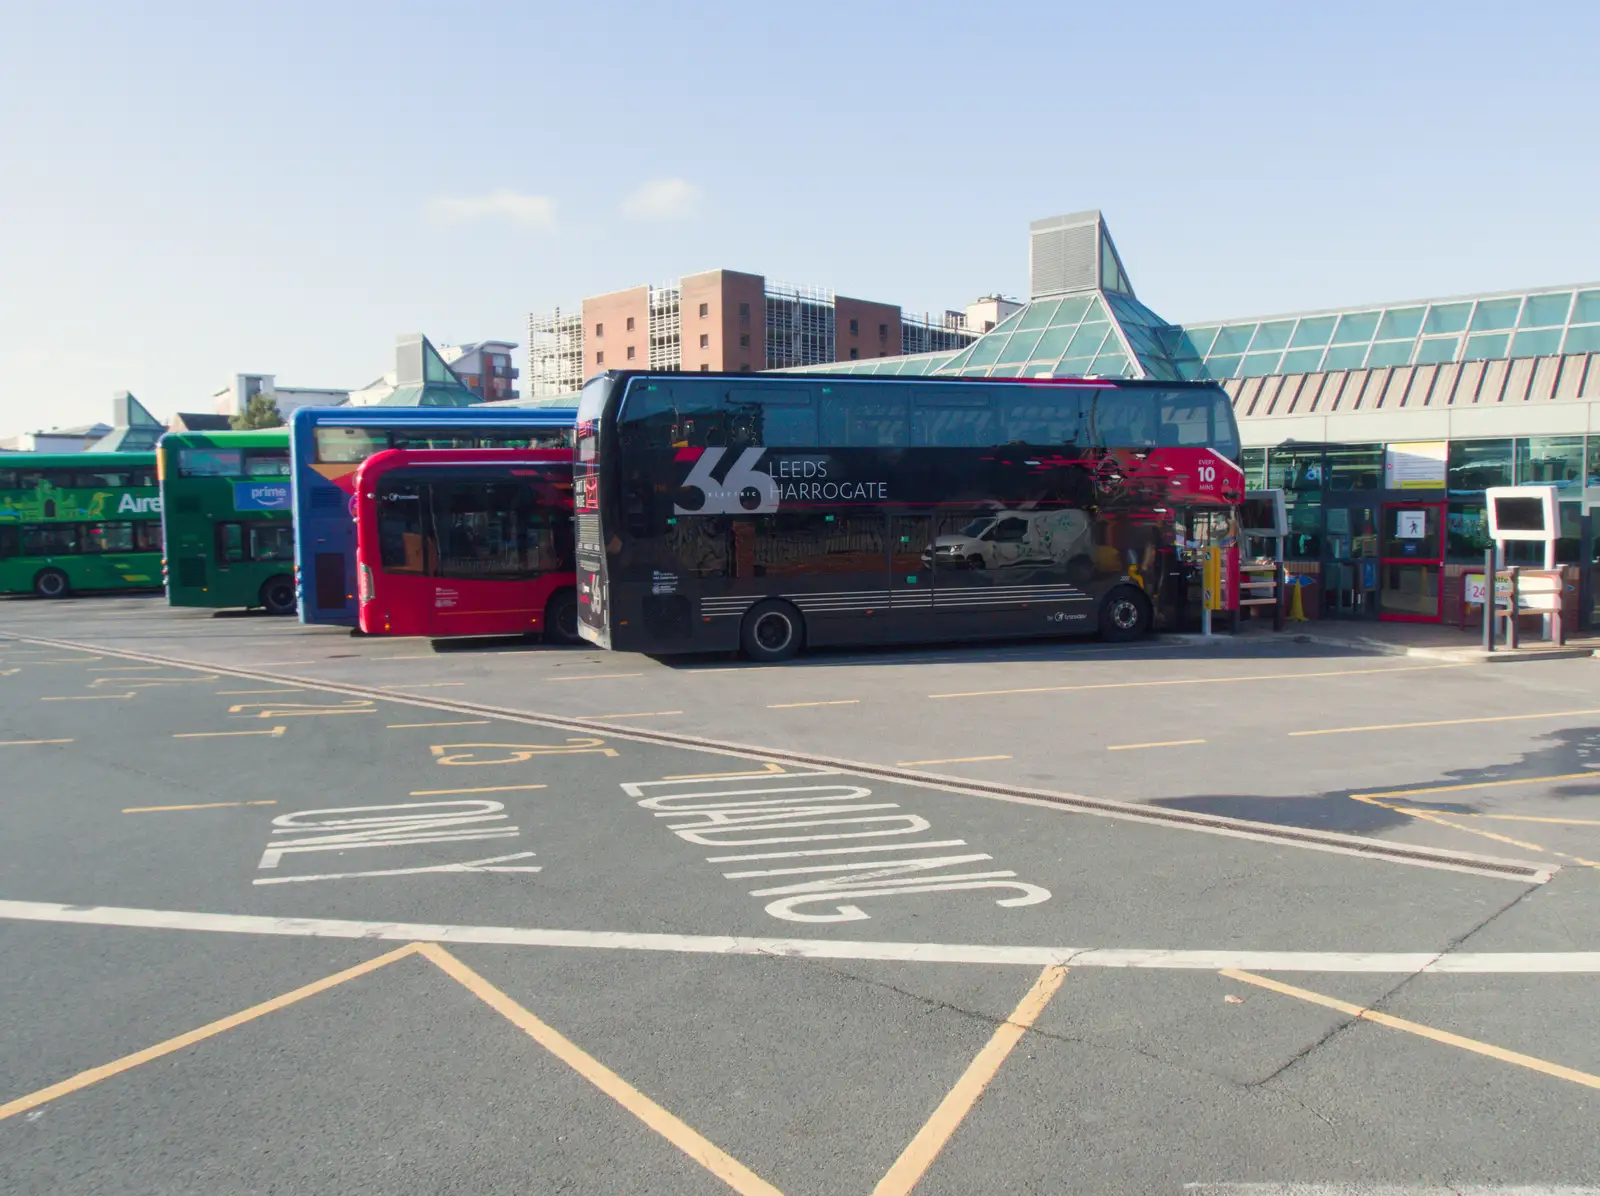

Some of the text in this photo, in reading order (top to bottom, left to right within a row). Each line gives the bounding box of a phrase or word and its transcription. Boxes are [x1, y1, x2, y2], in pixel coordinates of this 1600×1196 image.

[674, 447, 780, 515] 36
[769, 461, 828, 478] LEEDS
[1197, 466, 1216, 482] 10
[251, 486, 287, 499] prime
[769, 482, 888, 500] HARROGATE
[429, 737, 620, 766] 25
[252, 799, 544, 886] ONLY
[619, 770, 1053, 924] LOADING
